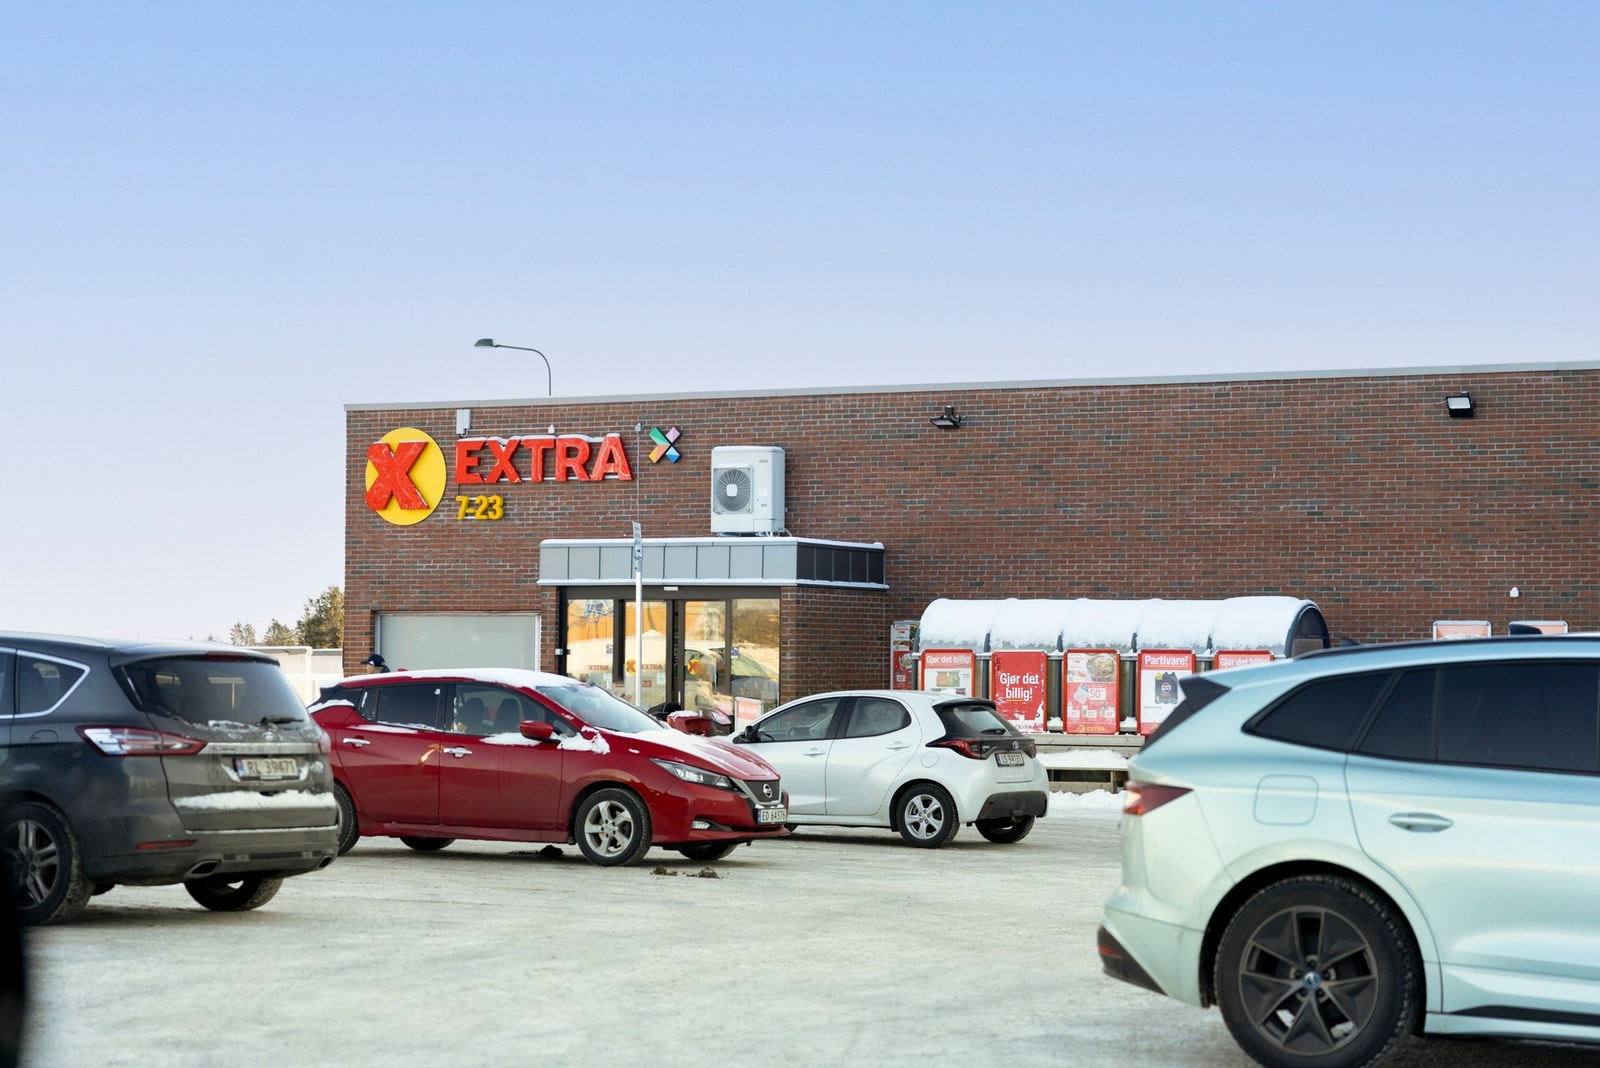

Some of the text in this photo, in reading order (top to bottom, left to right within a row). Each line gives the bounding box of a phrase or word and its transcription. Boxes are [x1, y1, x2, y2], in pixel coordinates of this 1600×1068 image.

[455, 433, 633, 483] EXTRA
[455, 495, 504, 521] 7-23
[926, 655, 940, 665] Gjør
[941, 655, 953, 664] det
[1144, 655, 1189, 666] Partivare!
[1000, 672, 1040, 687] Gjør det
[1006, 687, 1033, 701] billig!
[247, 760, 297, 775] RL 39471
[762, 810, 770, 822] ED
